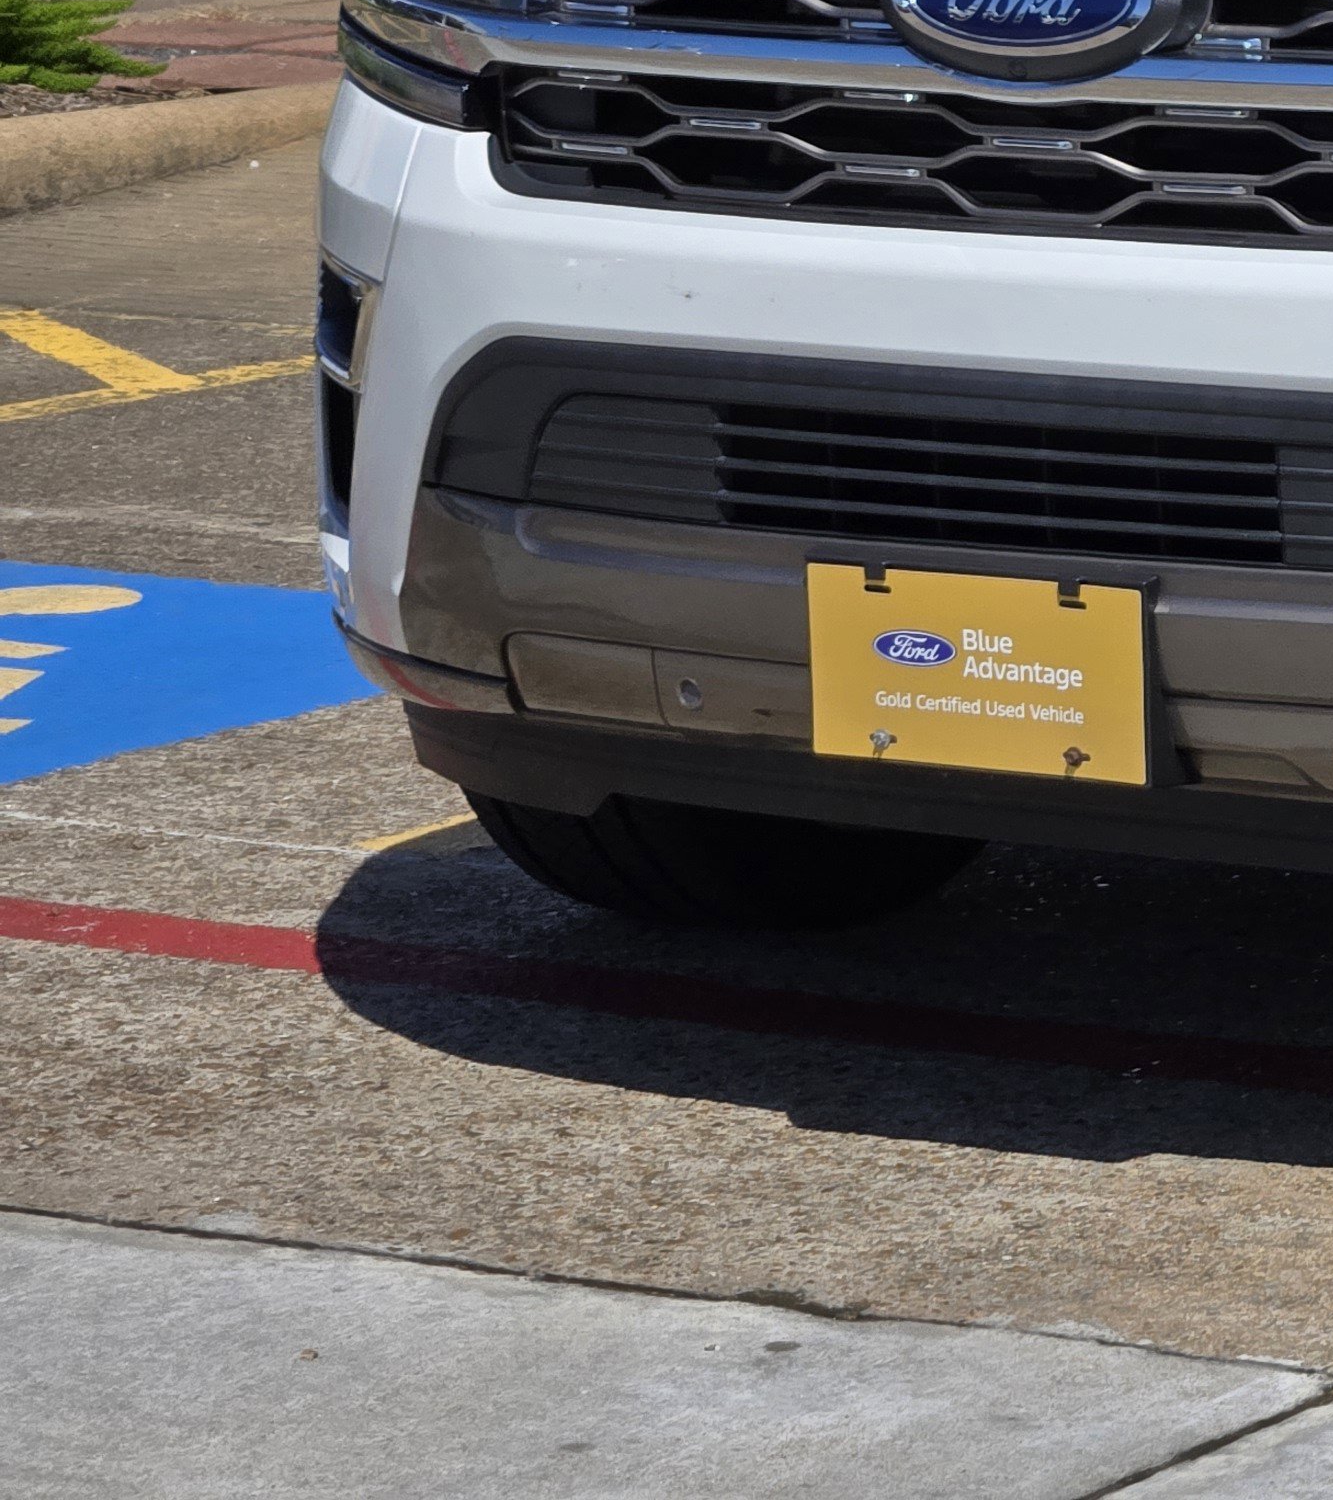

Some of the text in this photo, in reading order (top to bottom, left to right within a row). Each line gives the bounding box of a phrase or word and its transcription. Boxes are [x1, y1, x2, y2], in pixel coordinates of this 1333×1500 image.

[888, 634, 940, 662] Ford
[962, 629, 1013, 654] Blue
[963, 656, 1083, 691] Advantage
[875, 690, 1084, 725] Gold Certified Used Vehicle
